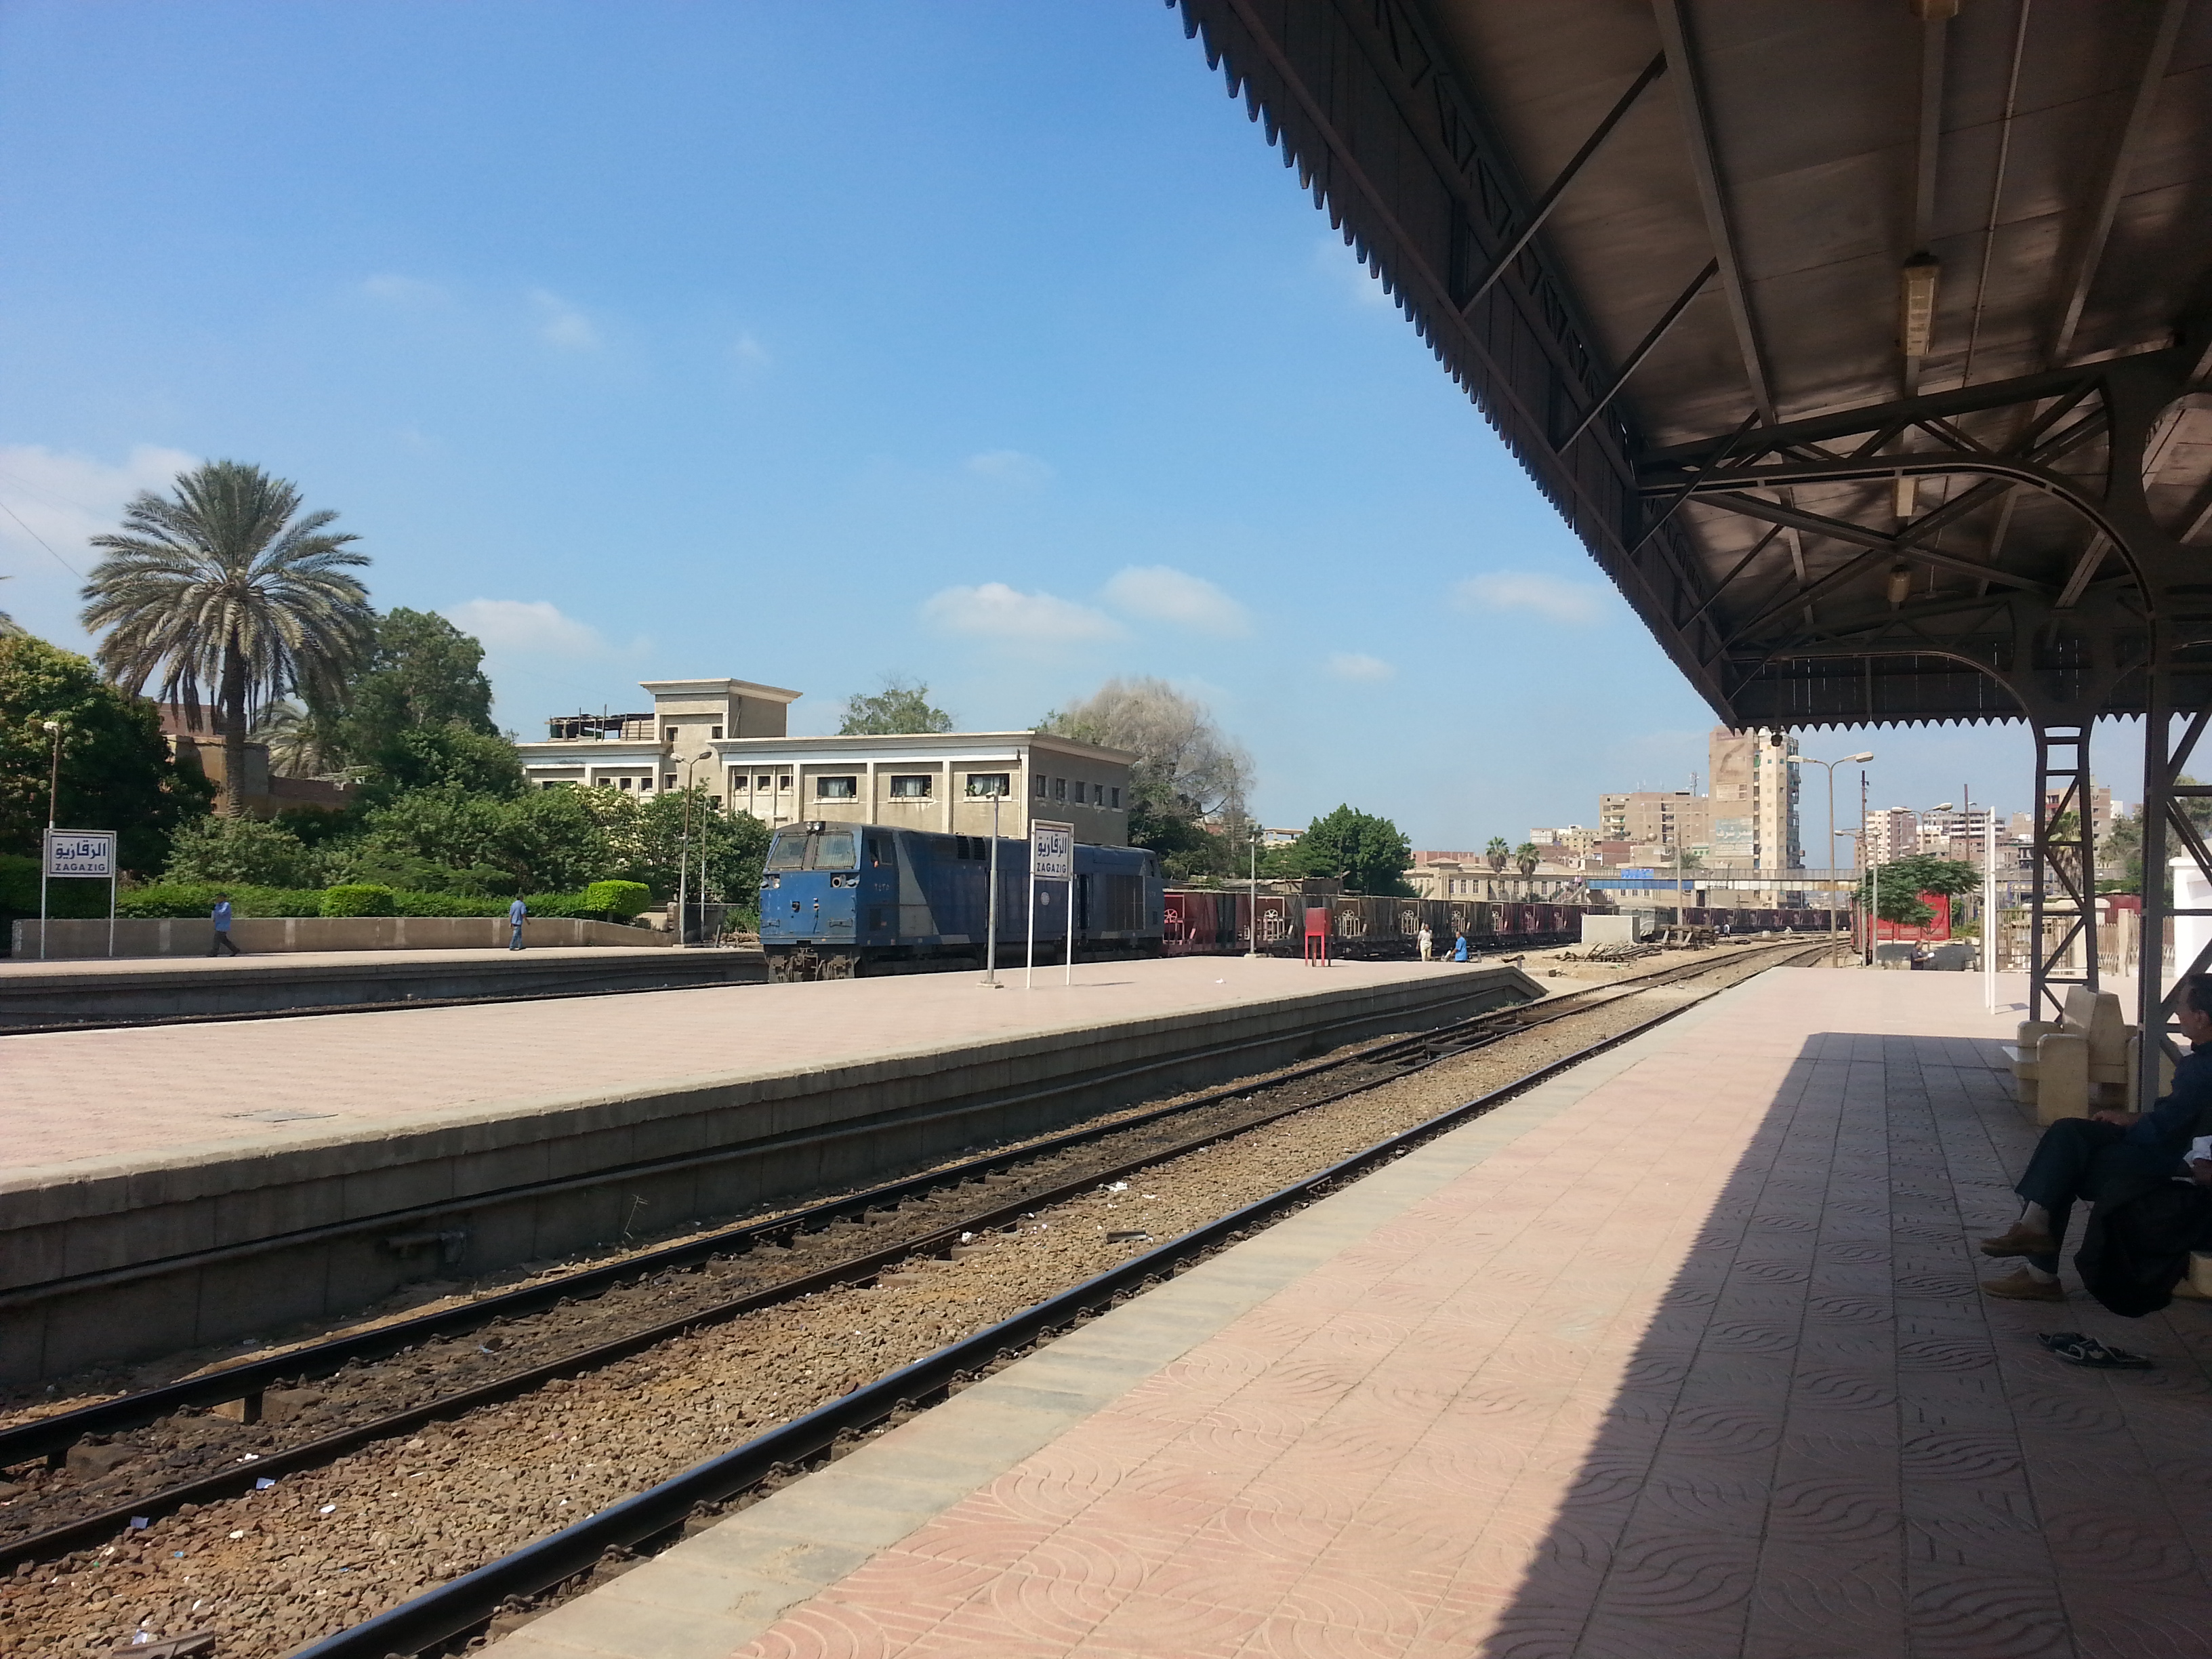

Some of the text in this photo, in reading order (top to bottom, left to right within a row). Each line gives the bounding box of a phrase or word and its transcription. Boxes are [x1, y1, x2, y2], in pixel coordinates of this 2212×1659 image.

[55, 840, 106, 859] الزقازيق
[1038, 834, 1067, 857] الزقازيق
[1037, 863, 1067, 873] ZAGAZIG
